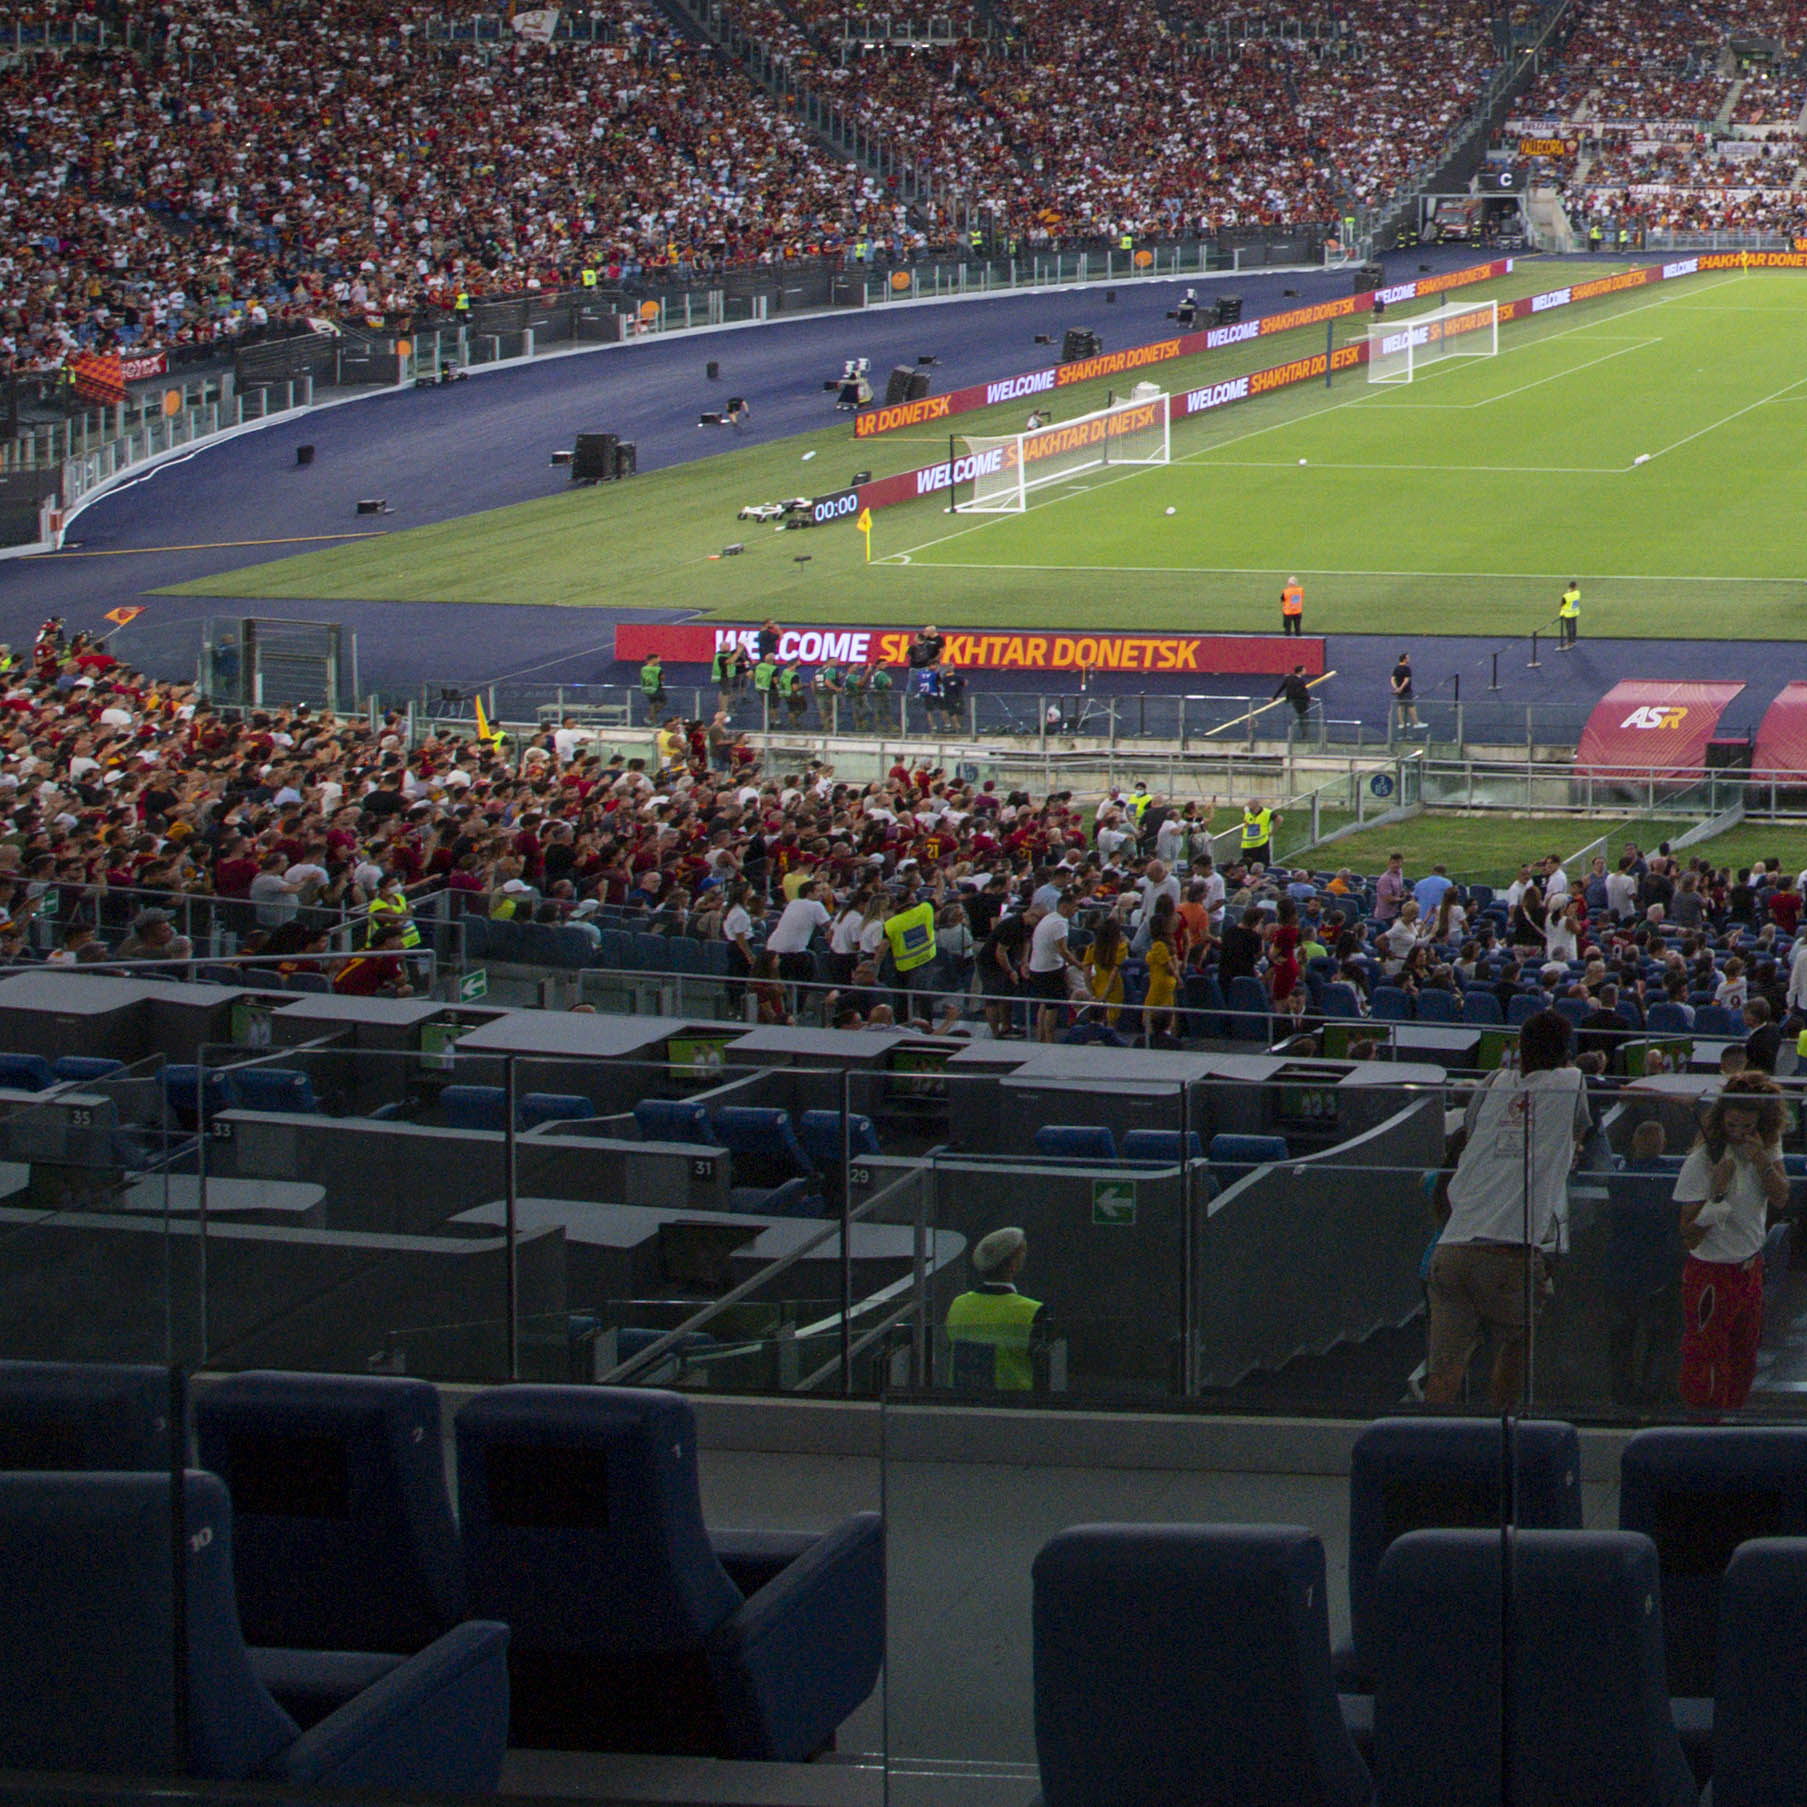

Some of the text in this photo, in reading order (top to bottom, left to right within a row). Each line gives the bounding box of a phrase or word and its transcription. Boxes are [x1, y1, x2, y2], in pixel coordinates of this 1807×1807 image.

[1500, 174, 1513, 187] C
[1531, 287, 1571, 313] WELCOME
[1206, 297, 1356, 348] WELCOME SHAKHTAR DONETSK
[986, 338, 1181, 405] WELCOME SHAKHTAR DONETSK
[1187, 378, 1249, 412] WELCOME
[1250, 362, 1309, 393] SHAKHTAR
[877, 395, 951, 433] DONETSK
[917, 448, 1003, 494] WELCOME
[815, 494, 857, 522] 00:00
[715, 629, 1200, 669] WECOME SHKHTAR DONETSK
[1621, 706, 1688, 729] ASR
[850, 1169, 869, 1184] 29
